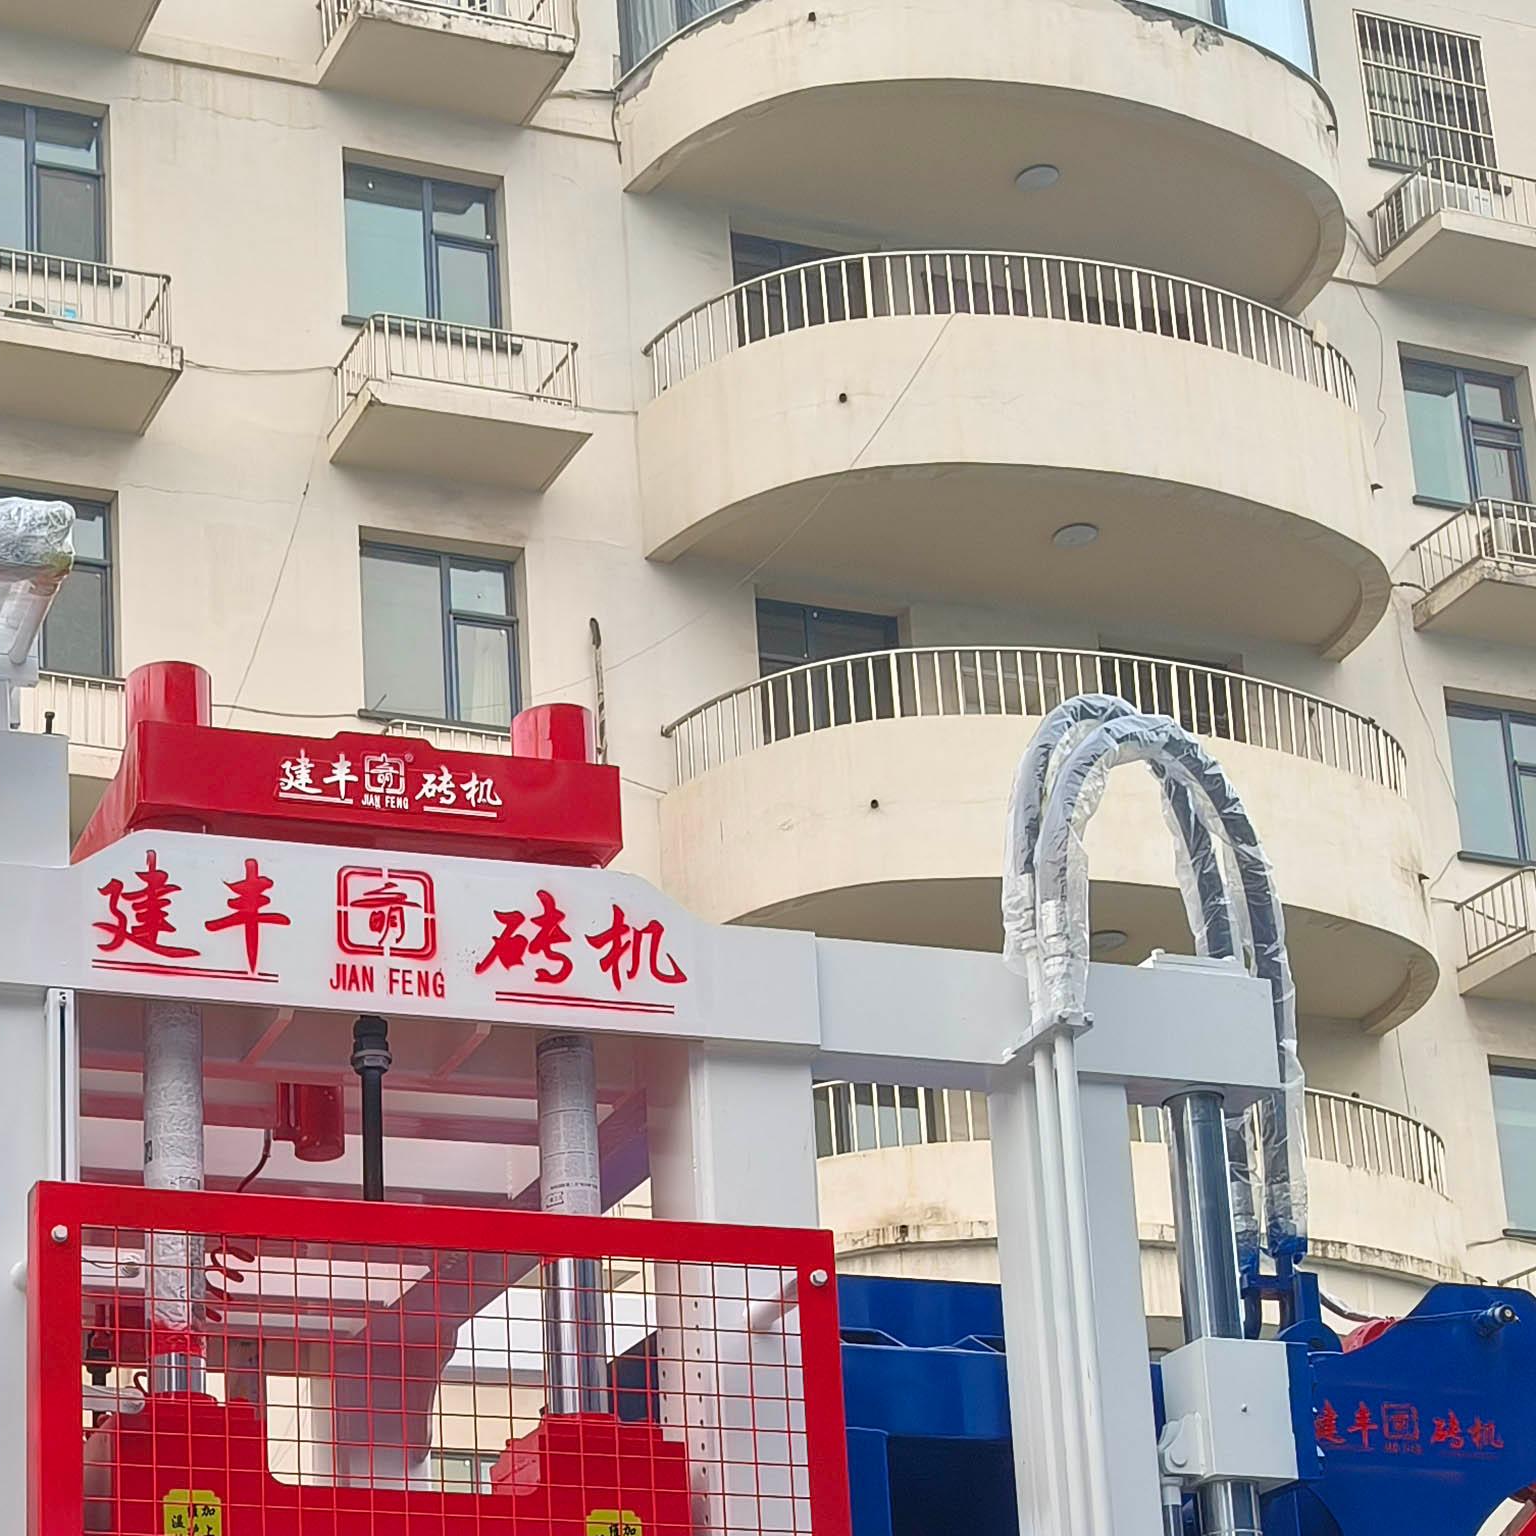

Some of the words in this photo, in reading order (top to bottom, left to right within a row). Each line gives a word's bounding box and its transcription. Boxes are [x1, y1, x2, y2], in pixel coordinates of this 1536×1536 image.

[280, 748, 359, 801] 建丰
[415, 765, 503, 808] 砖机
[362, 793, 382, 809] JIAN
[384, 793, 409, 810] FENG
[92, 849, 292, 974] 建丰
[475, 889, 688, 992] 砖机
[330, 963, 375, 992] JIAN
[388, 967, 446, 1000] FENG
[1430, 1409, 1504, 1449] 砖机
